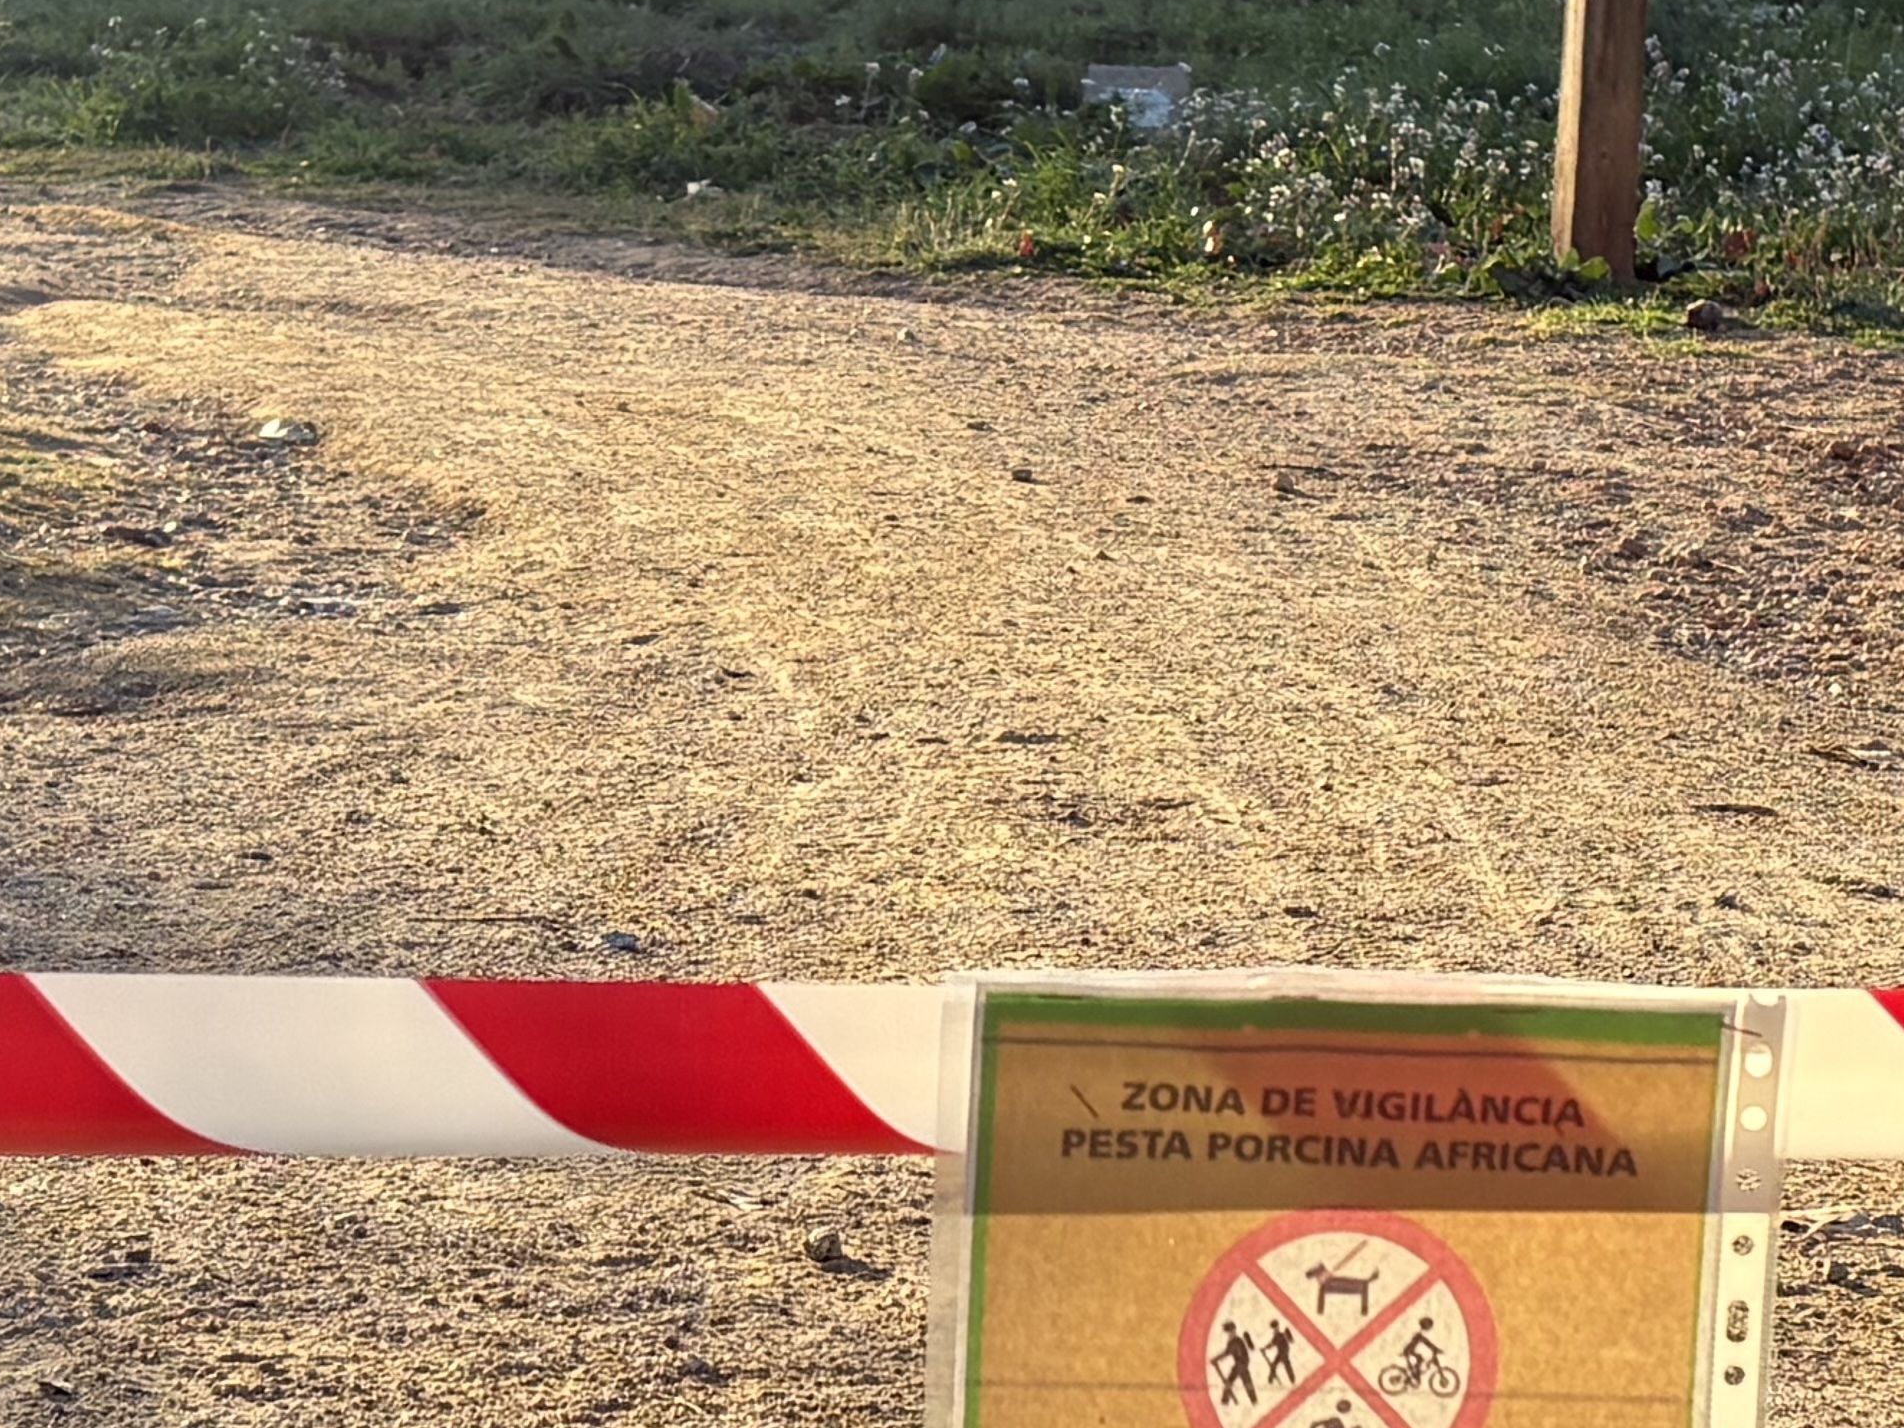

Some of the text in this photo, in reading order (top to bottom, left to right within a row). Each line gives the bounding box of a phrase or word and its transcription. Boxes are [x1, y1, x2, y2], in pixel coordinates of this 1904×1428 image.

[1121, 1081, 1585, 1127] ZONA DE VIGILÀNCIA
[1061, 1128, 1638, 1177] PESTA PORCINA AFRICANA
